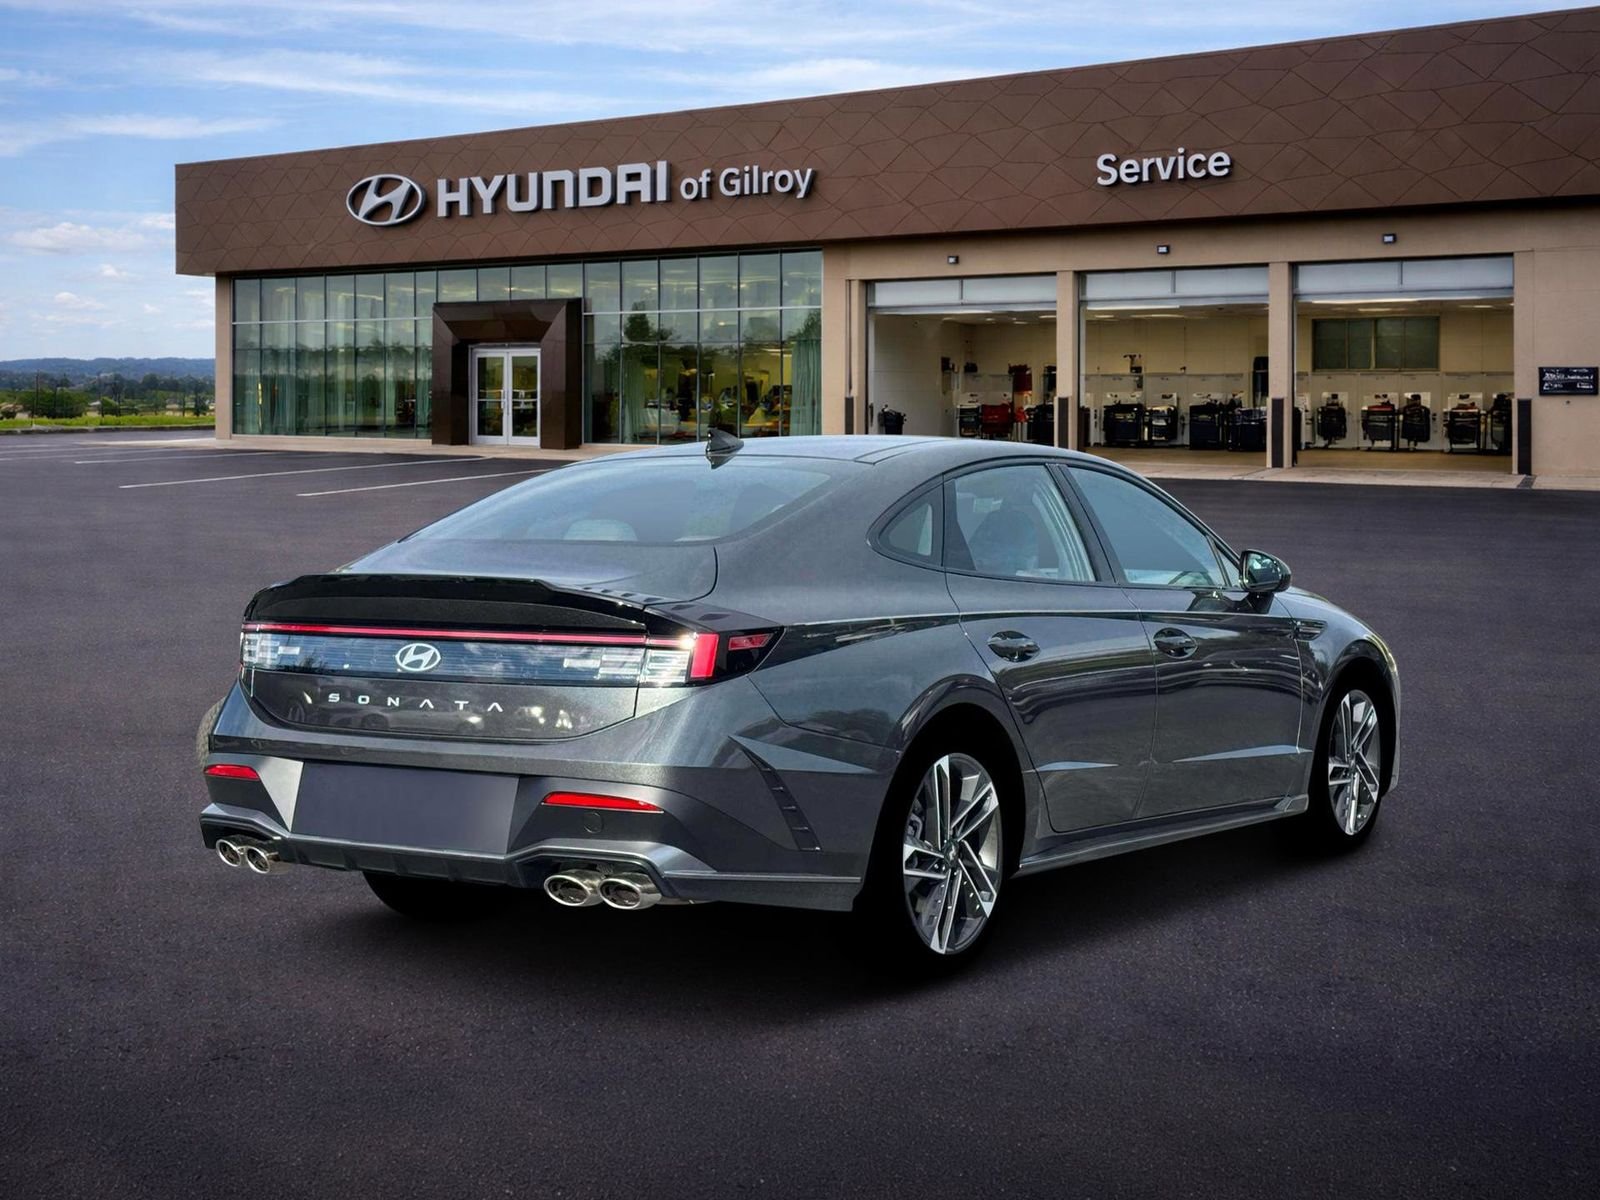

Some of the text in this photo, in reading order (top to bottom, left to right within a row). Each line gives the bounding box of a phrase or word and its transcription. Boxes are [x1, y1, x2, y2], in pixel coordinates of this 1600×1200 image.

[1096, 147, 1231, 186] Service
[436, 160, 814, 217] HYUNDAI of Gilroy
[328, 692, 503, 712] SONATA
